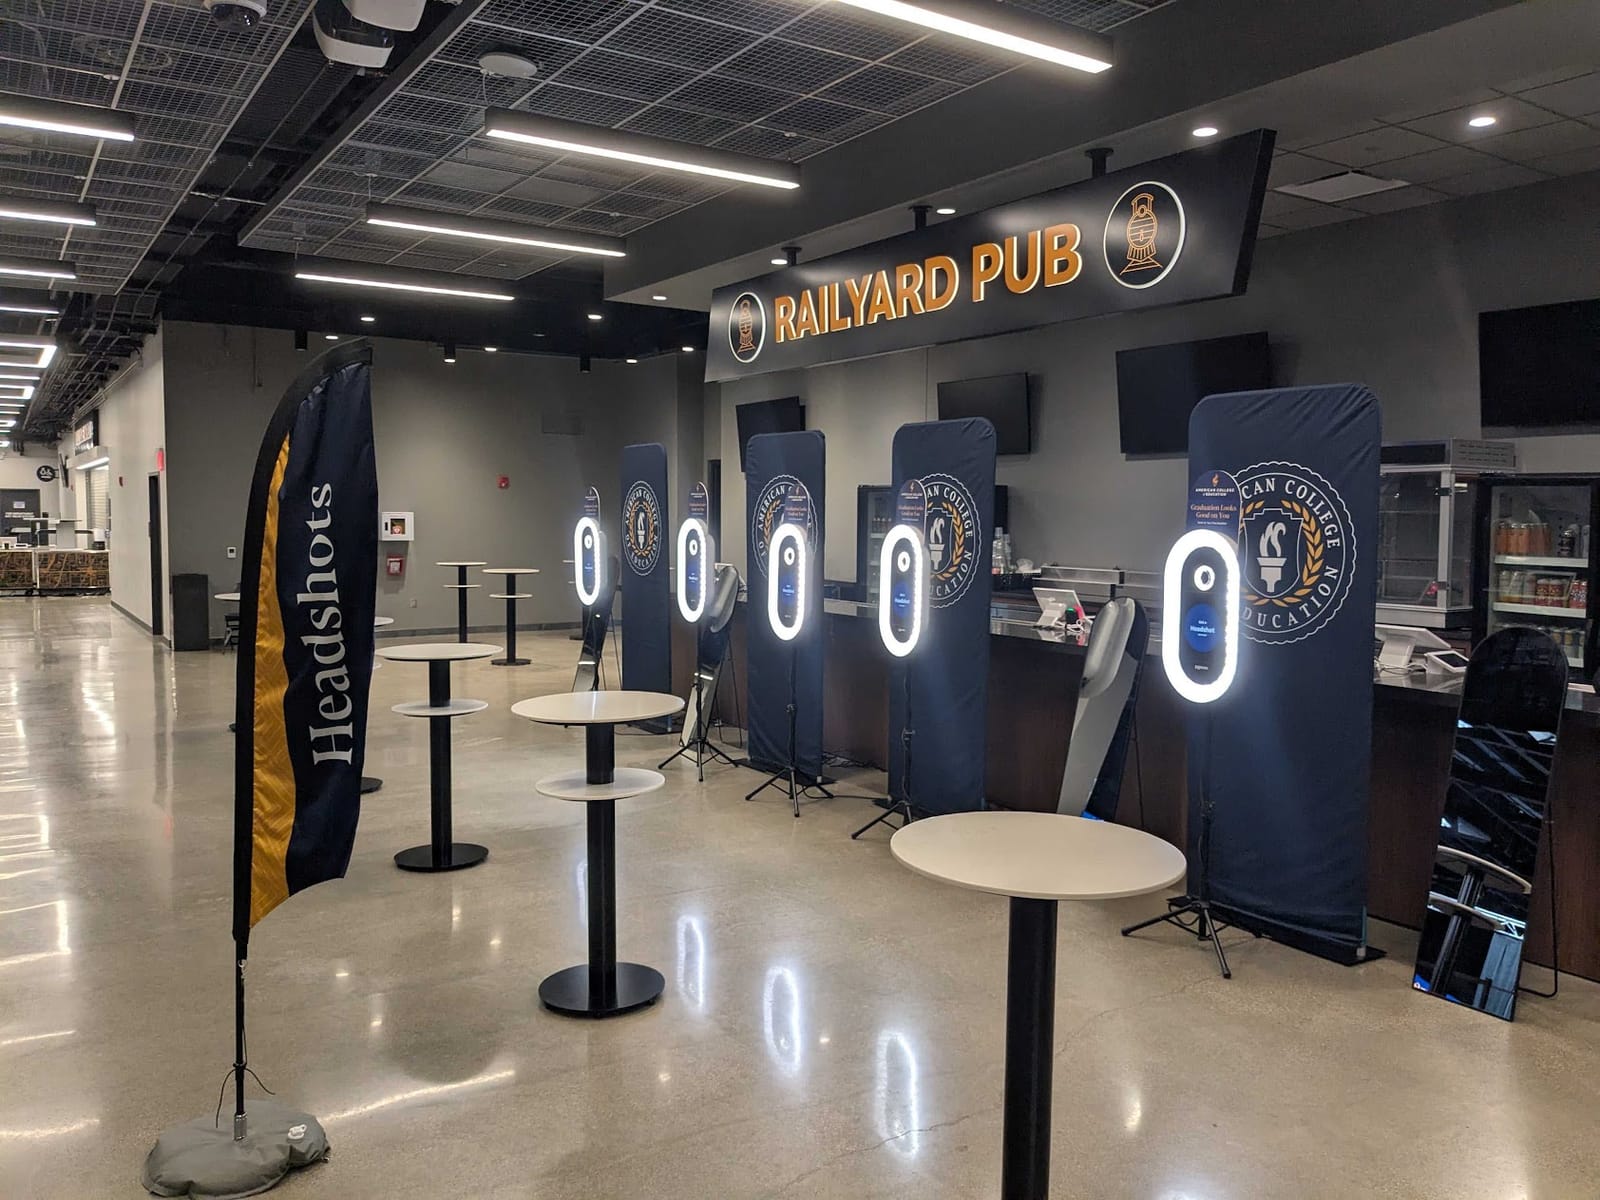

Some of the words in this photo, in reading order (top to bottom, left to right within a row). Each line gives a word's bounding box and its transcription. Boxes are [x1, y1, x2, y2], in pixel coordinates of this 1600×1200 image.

[775, 255, 959, 343] RAILYARD
[972, 223, 1083, 302] PUB
[758, 485, 785, 530] AMERICAN
[943, 486, 973, 537] COLLEGE
[1285, 479, 1340, 548] COLLEGE
[296, 482, 353, 766] Headshots
[1241, 565, 1338, 628] DUCATION
